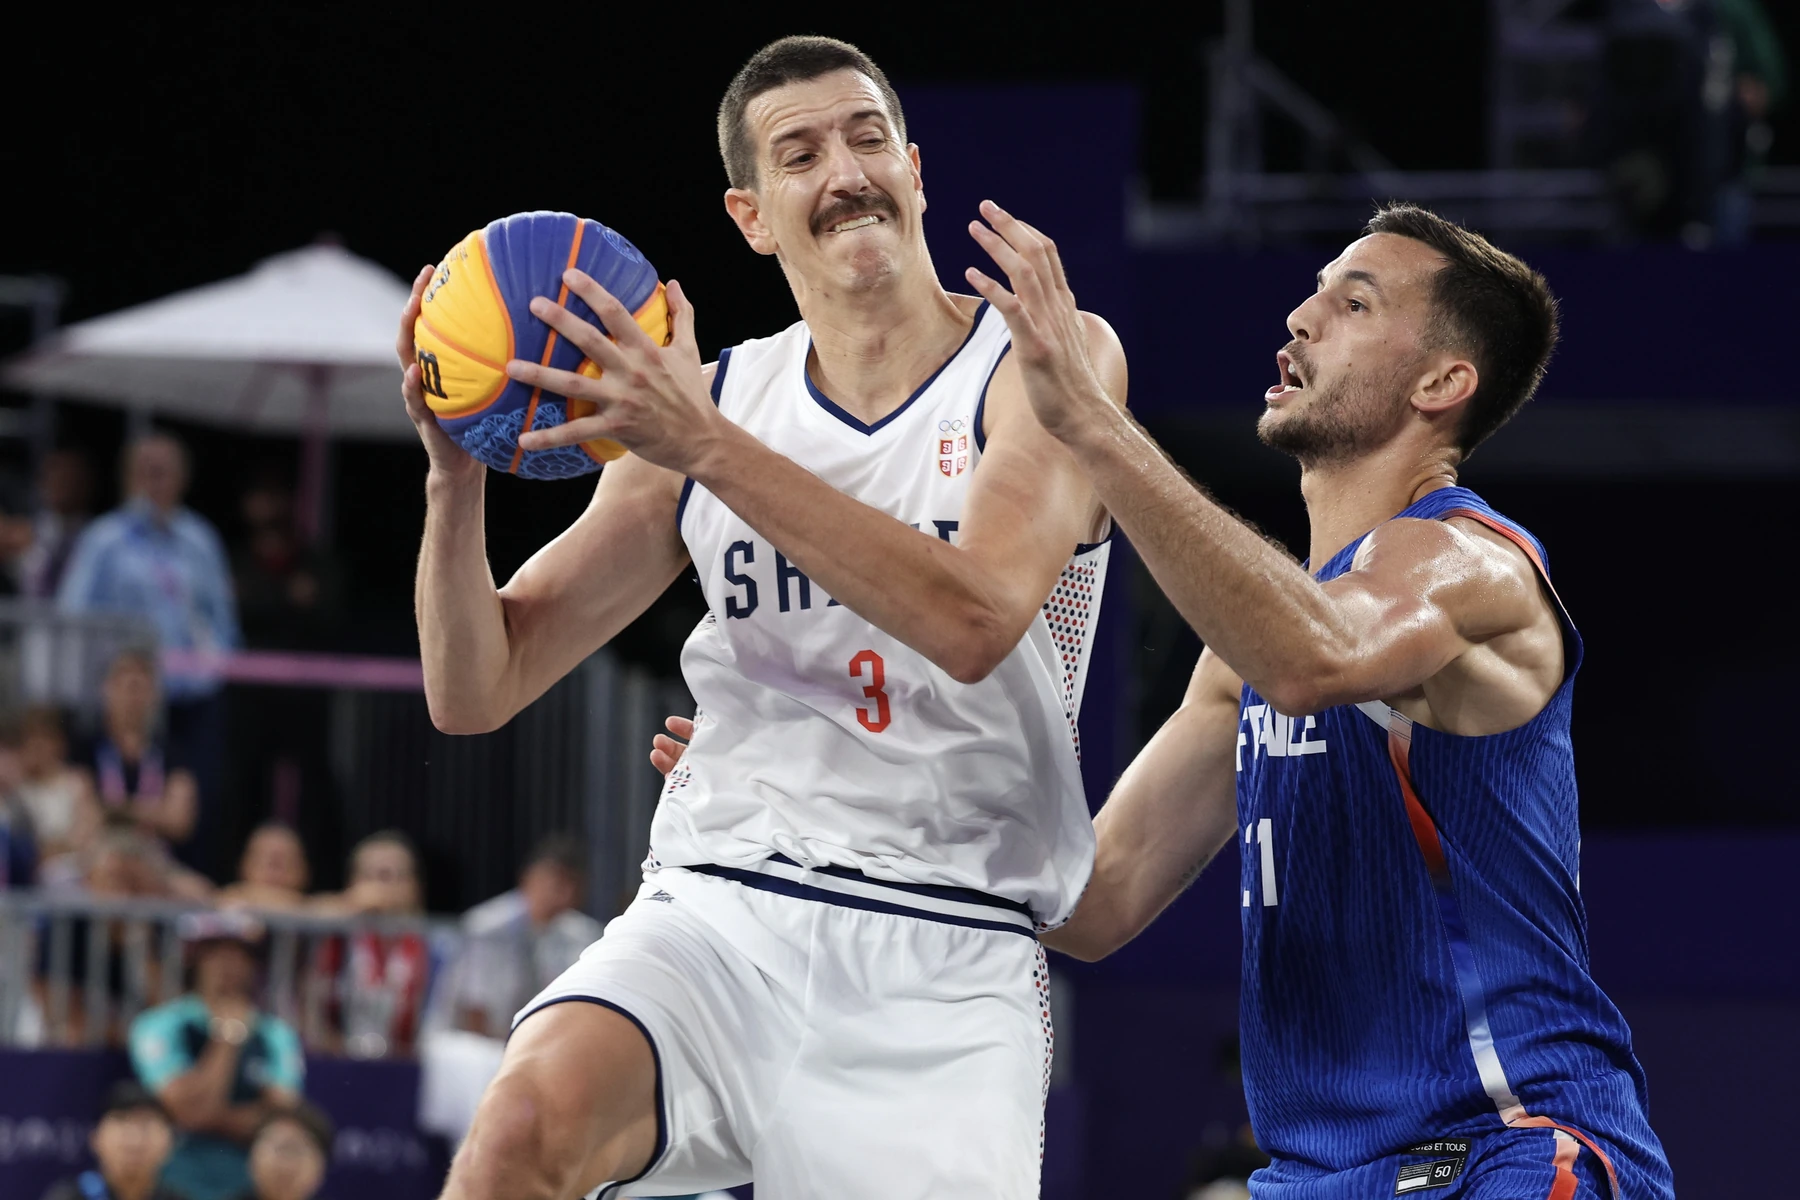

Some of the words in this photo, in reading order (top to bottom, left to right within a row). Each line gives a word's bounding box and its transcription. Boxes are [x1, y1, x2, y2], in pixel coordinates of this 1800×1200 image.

[849, 649, 891, 733] 3
[1434, 1142, 1443, 1151] ET
[1445, 1143, 1467, 1152] TOUS
[1434, 1165, 1451, 1178] 50
